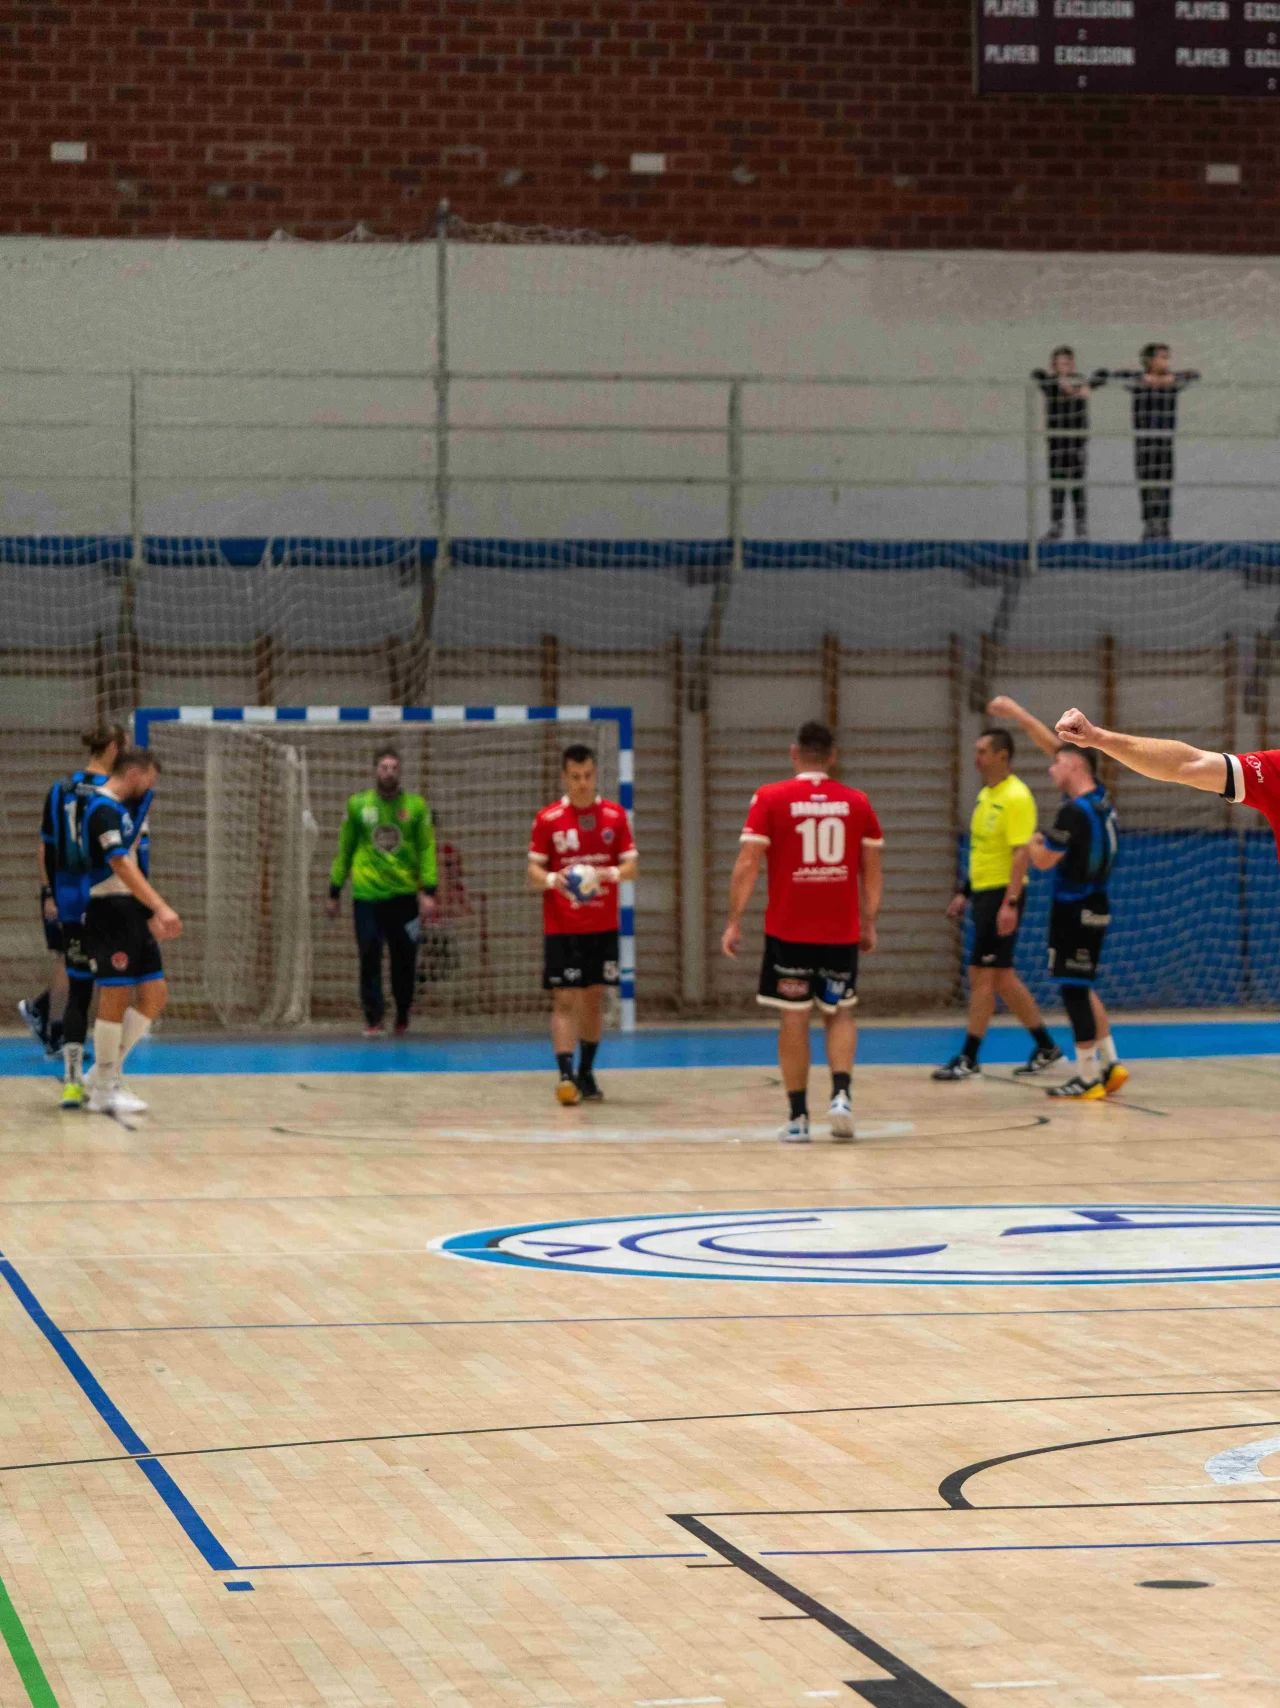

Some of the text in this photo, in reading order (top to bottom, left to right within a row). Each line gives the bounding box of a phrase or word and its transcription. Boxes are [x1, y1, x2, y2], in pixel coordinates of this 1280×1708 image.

[984, 45, 1136, 66] PLAYER EXCLUSION
[1176, 48, 1231, 67] PLAYER
[552, 828, 580, 854] 54
[795, 817, 846, 865] 10
